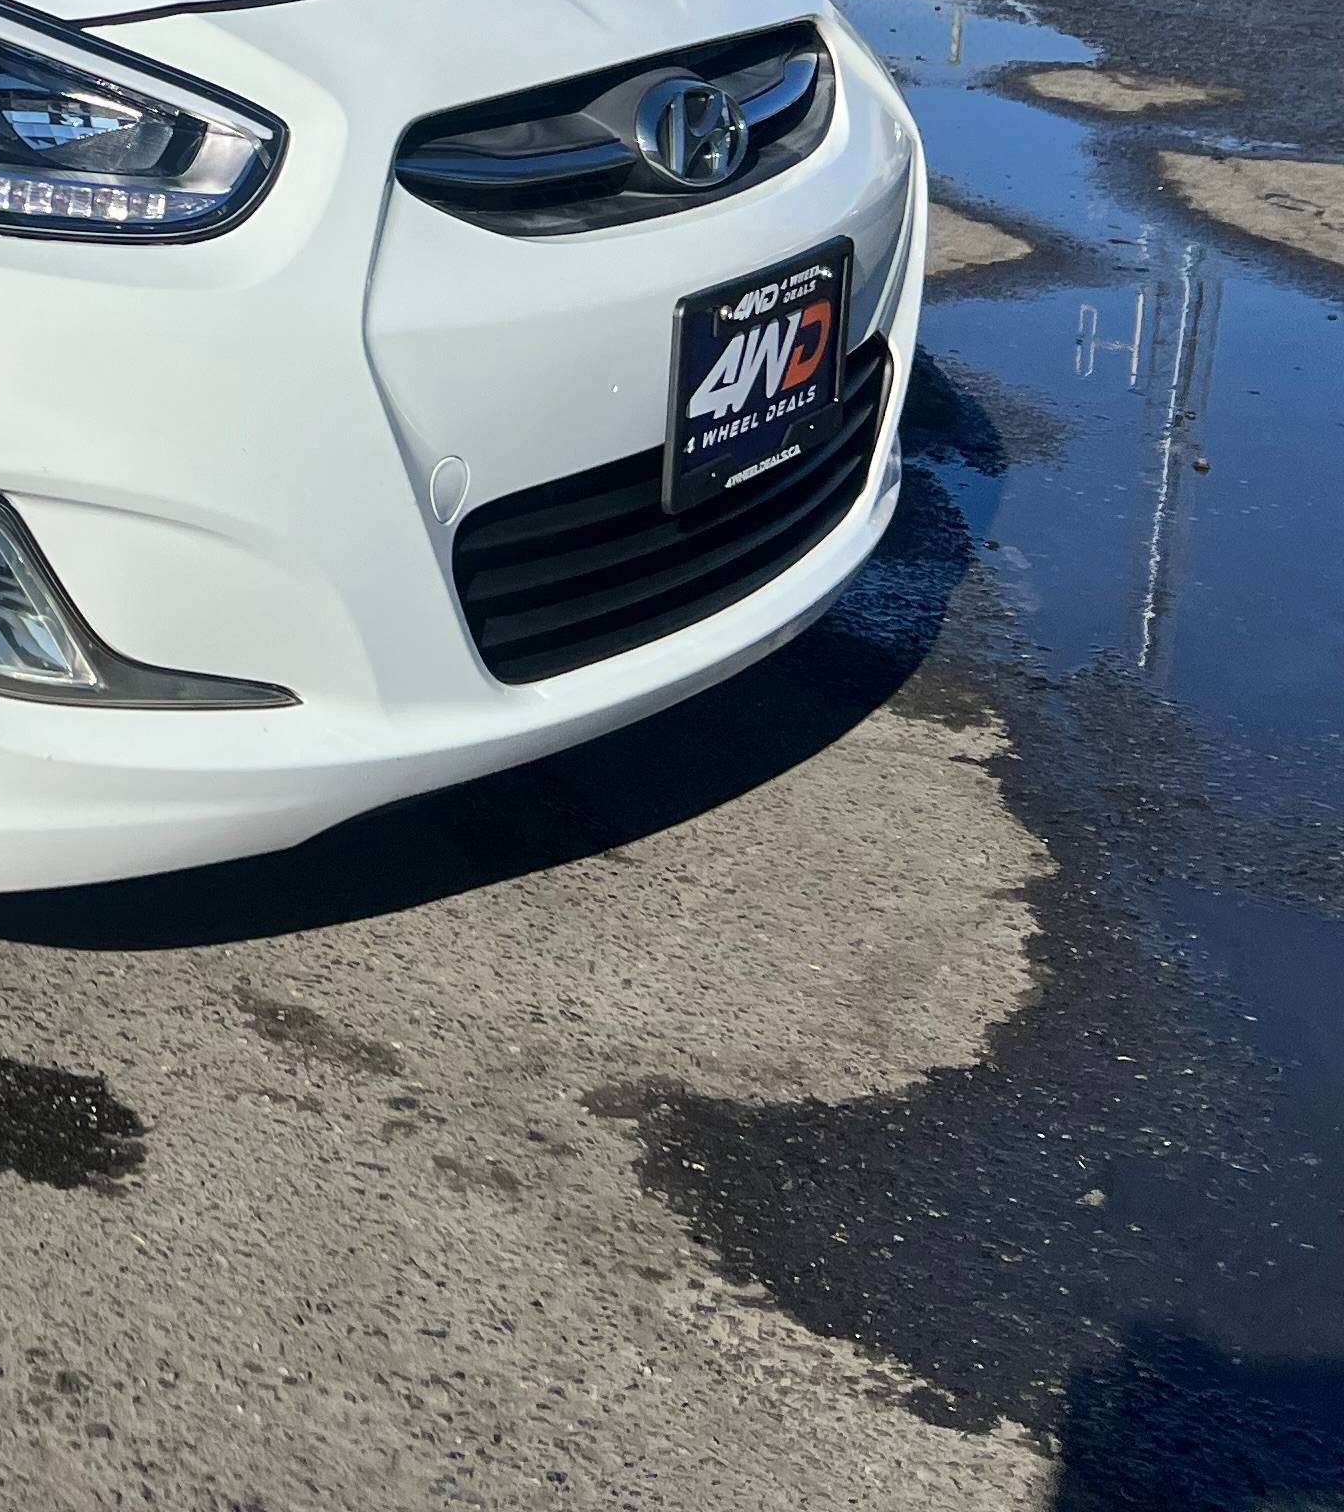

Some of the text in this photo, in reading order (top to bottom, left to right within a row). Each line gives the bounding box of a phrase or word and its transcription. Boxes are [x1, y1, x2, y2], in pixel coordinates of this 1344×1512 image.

[686, 299, 832, 420] 4WD
[702, 413, 760, 448] WHEEL
[765, 384, 817, 423] DEALS
